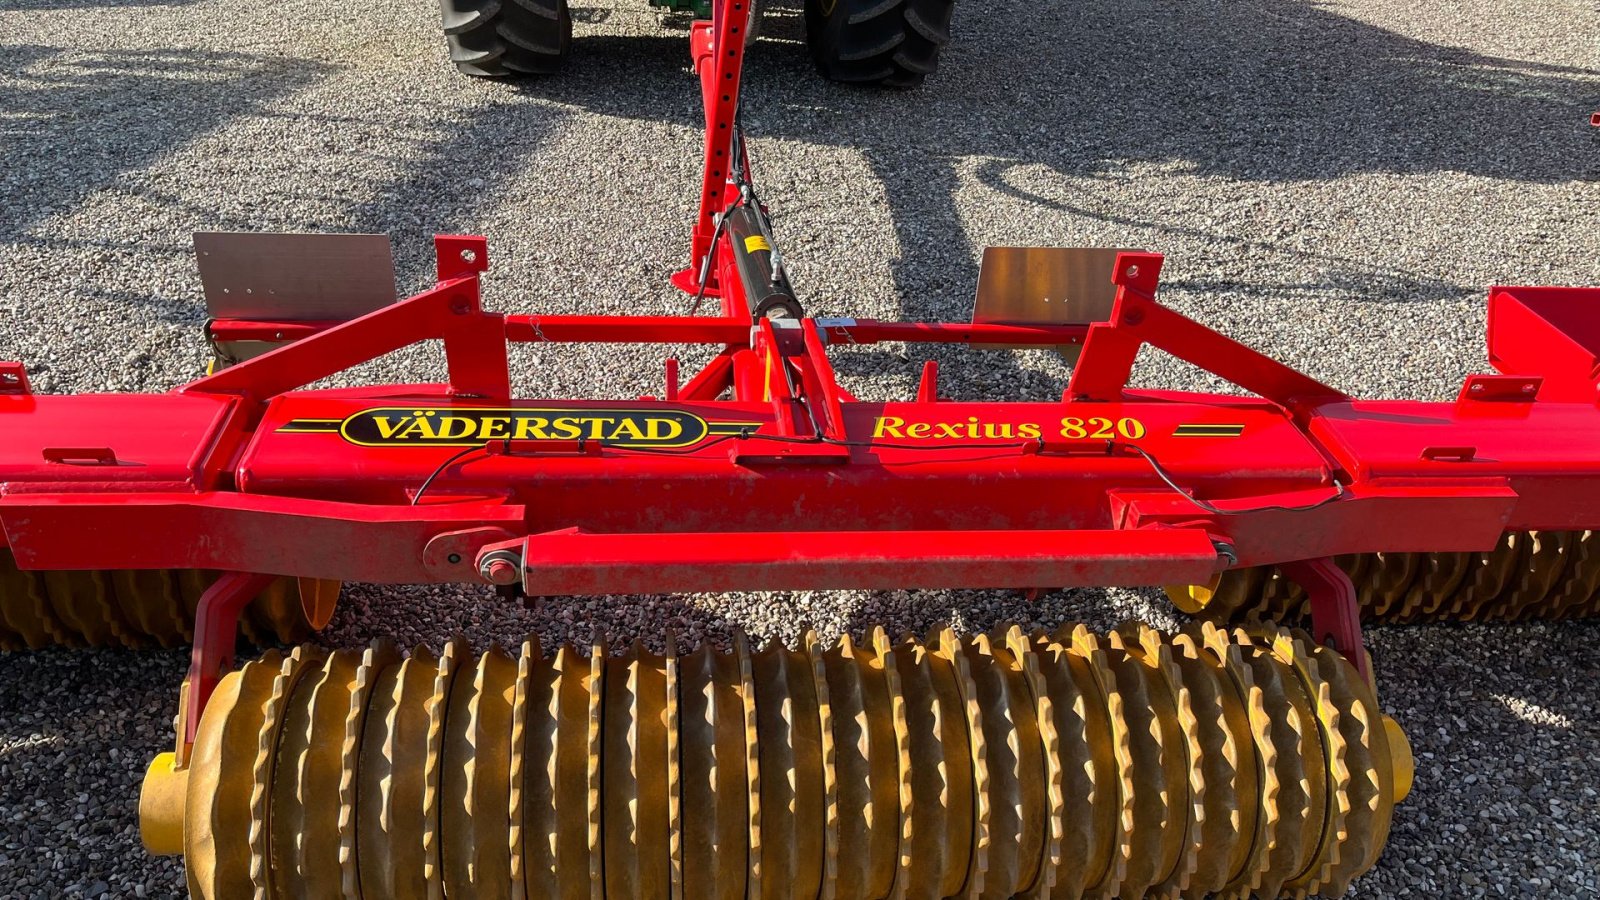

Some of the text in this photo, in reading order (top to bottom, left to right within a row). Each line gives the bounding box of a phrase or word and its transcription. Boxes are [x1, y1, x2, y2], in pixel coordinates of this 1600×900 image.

[372, 410, 683, 440] VÄDERSTAD
[872, 416, 1146, 439] Rexius 820
